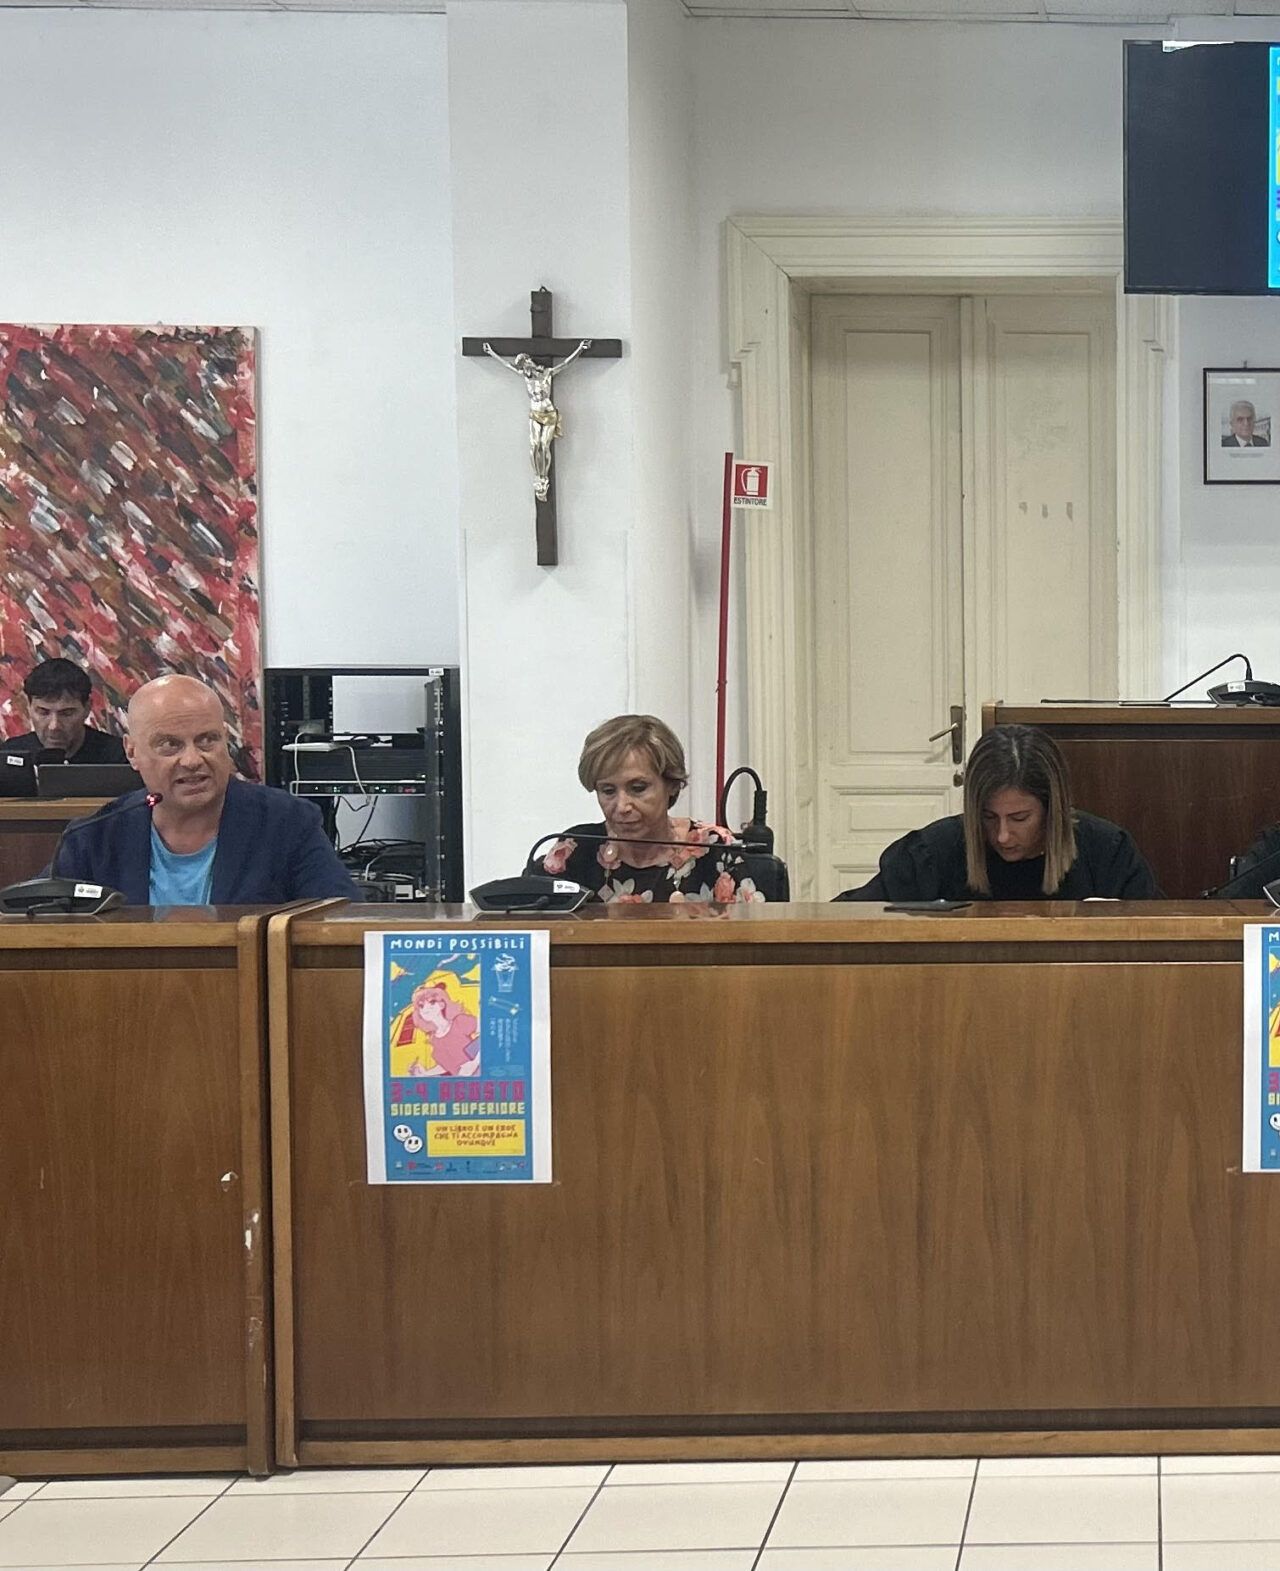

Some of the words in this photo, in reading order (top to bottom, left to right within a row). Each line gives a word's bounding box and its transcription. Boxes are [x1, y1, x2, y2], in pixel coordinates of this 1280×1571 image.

[734, 497, 767, 506] ESTINTORE
[439, 1081, 525, 1102] AGOSTO
[390, 1102, 447, 1116] SIDERNO
[452, 1102, 526, 1116] SUPERIORE
